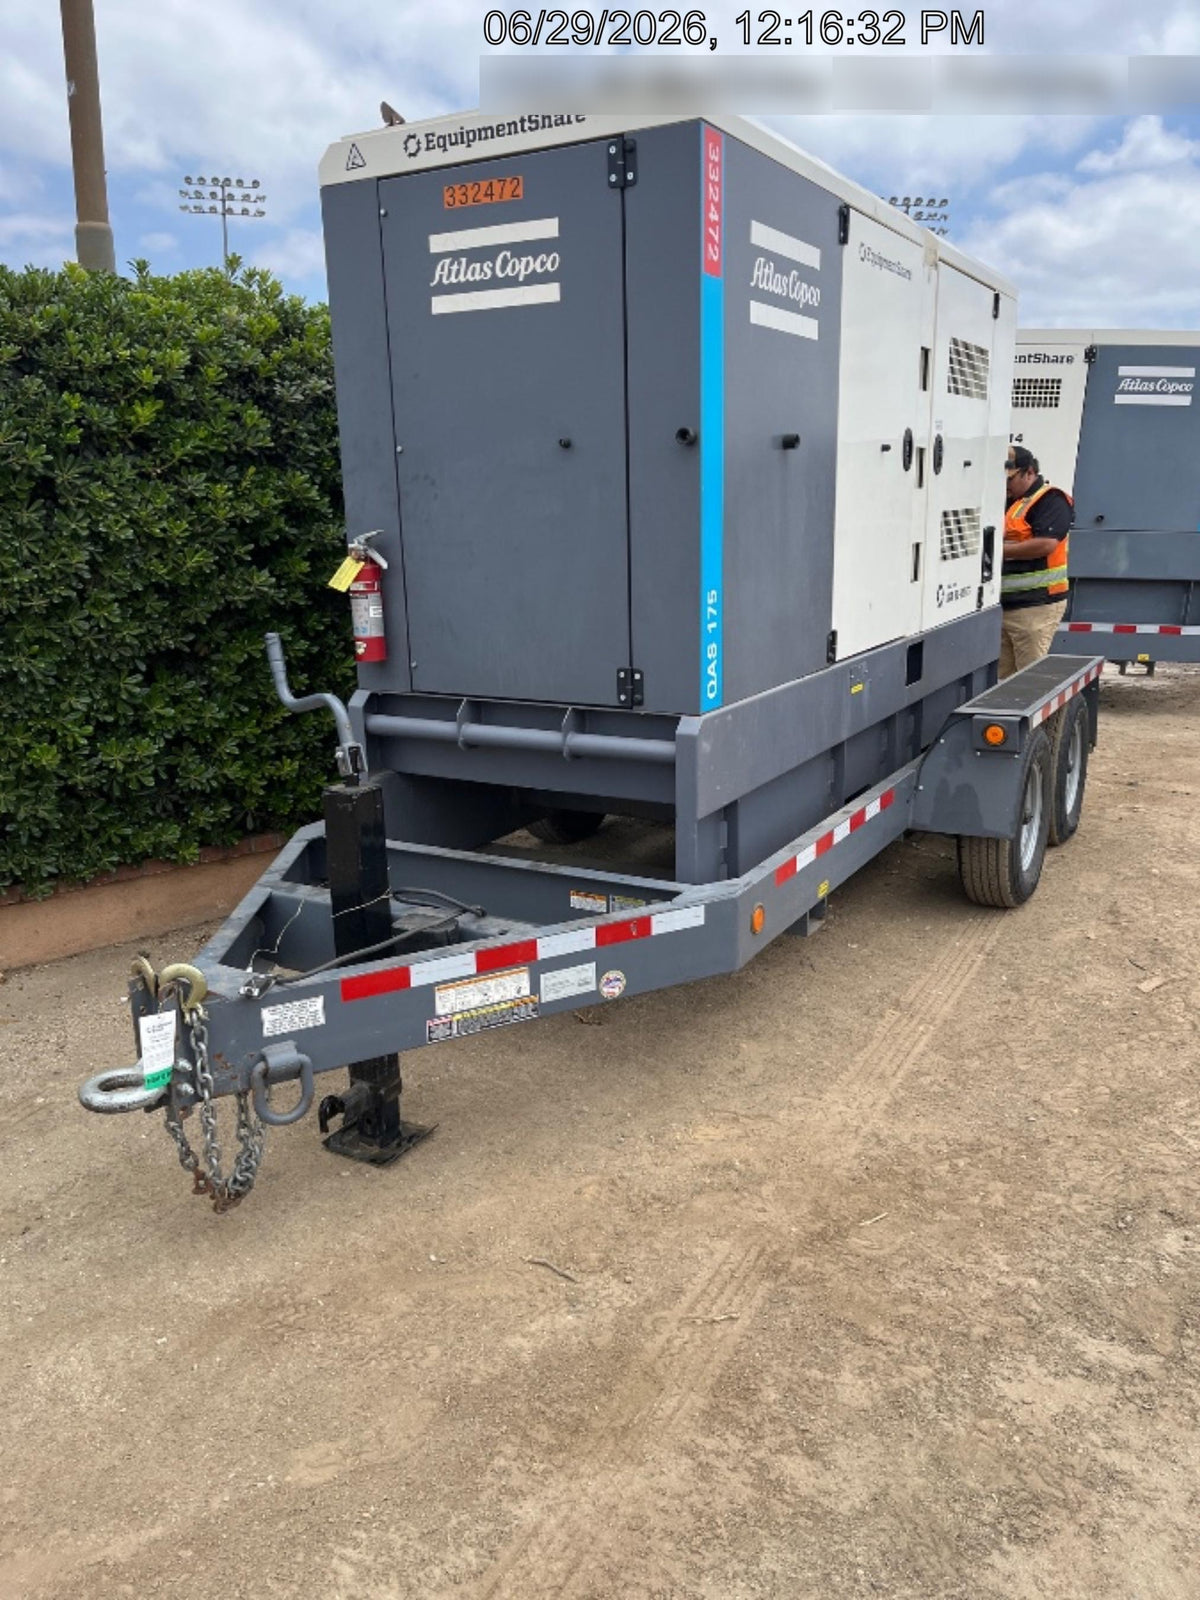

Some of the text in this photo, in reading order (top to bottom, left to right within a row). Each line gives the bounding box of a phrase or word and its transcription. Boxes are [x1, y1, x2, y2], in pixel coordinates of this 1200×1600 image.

[444, 176, 521, 208] 332472
[708, 141, 719, 263] 332472
[430, 250, 560, 287] Atlas Copco
[750, 257, 821, 309] Atlas Copco
[1116, 377, 1194, 394] Atlas Copco
[706, 589, 718, 634] 175
